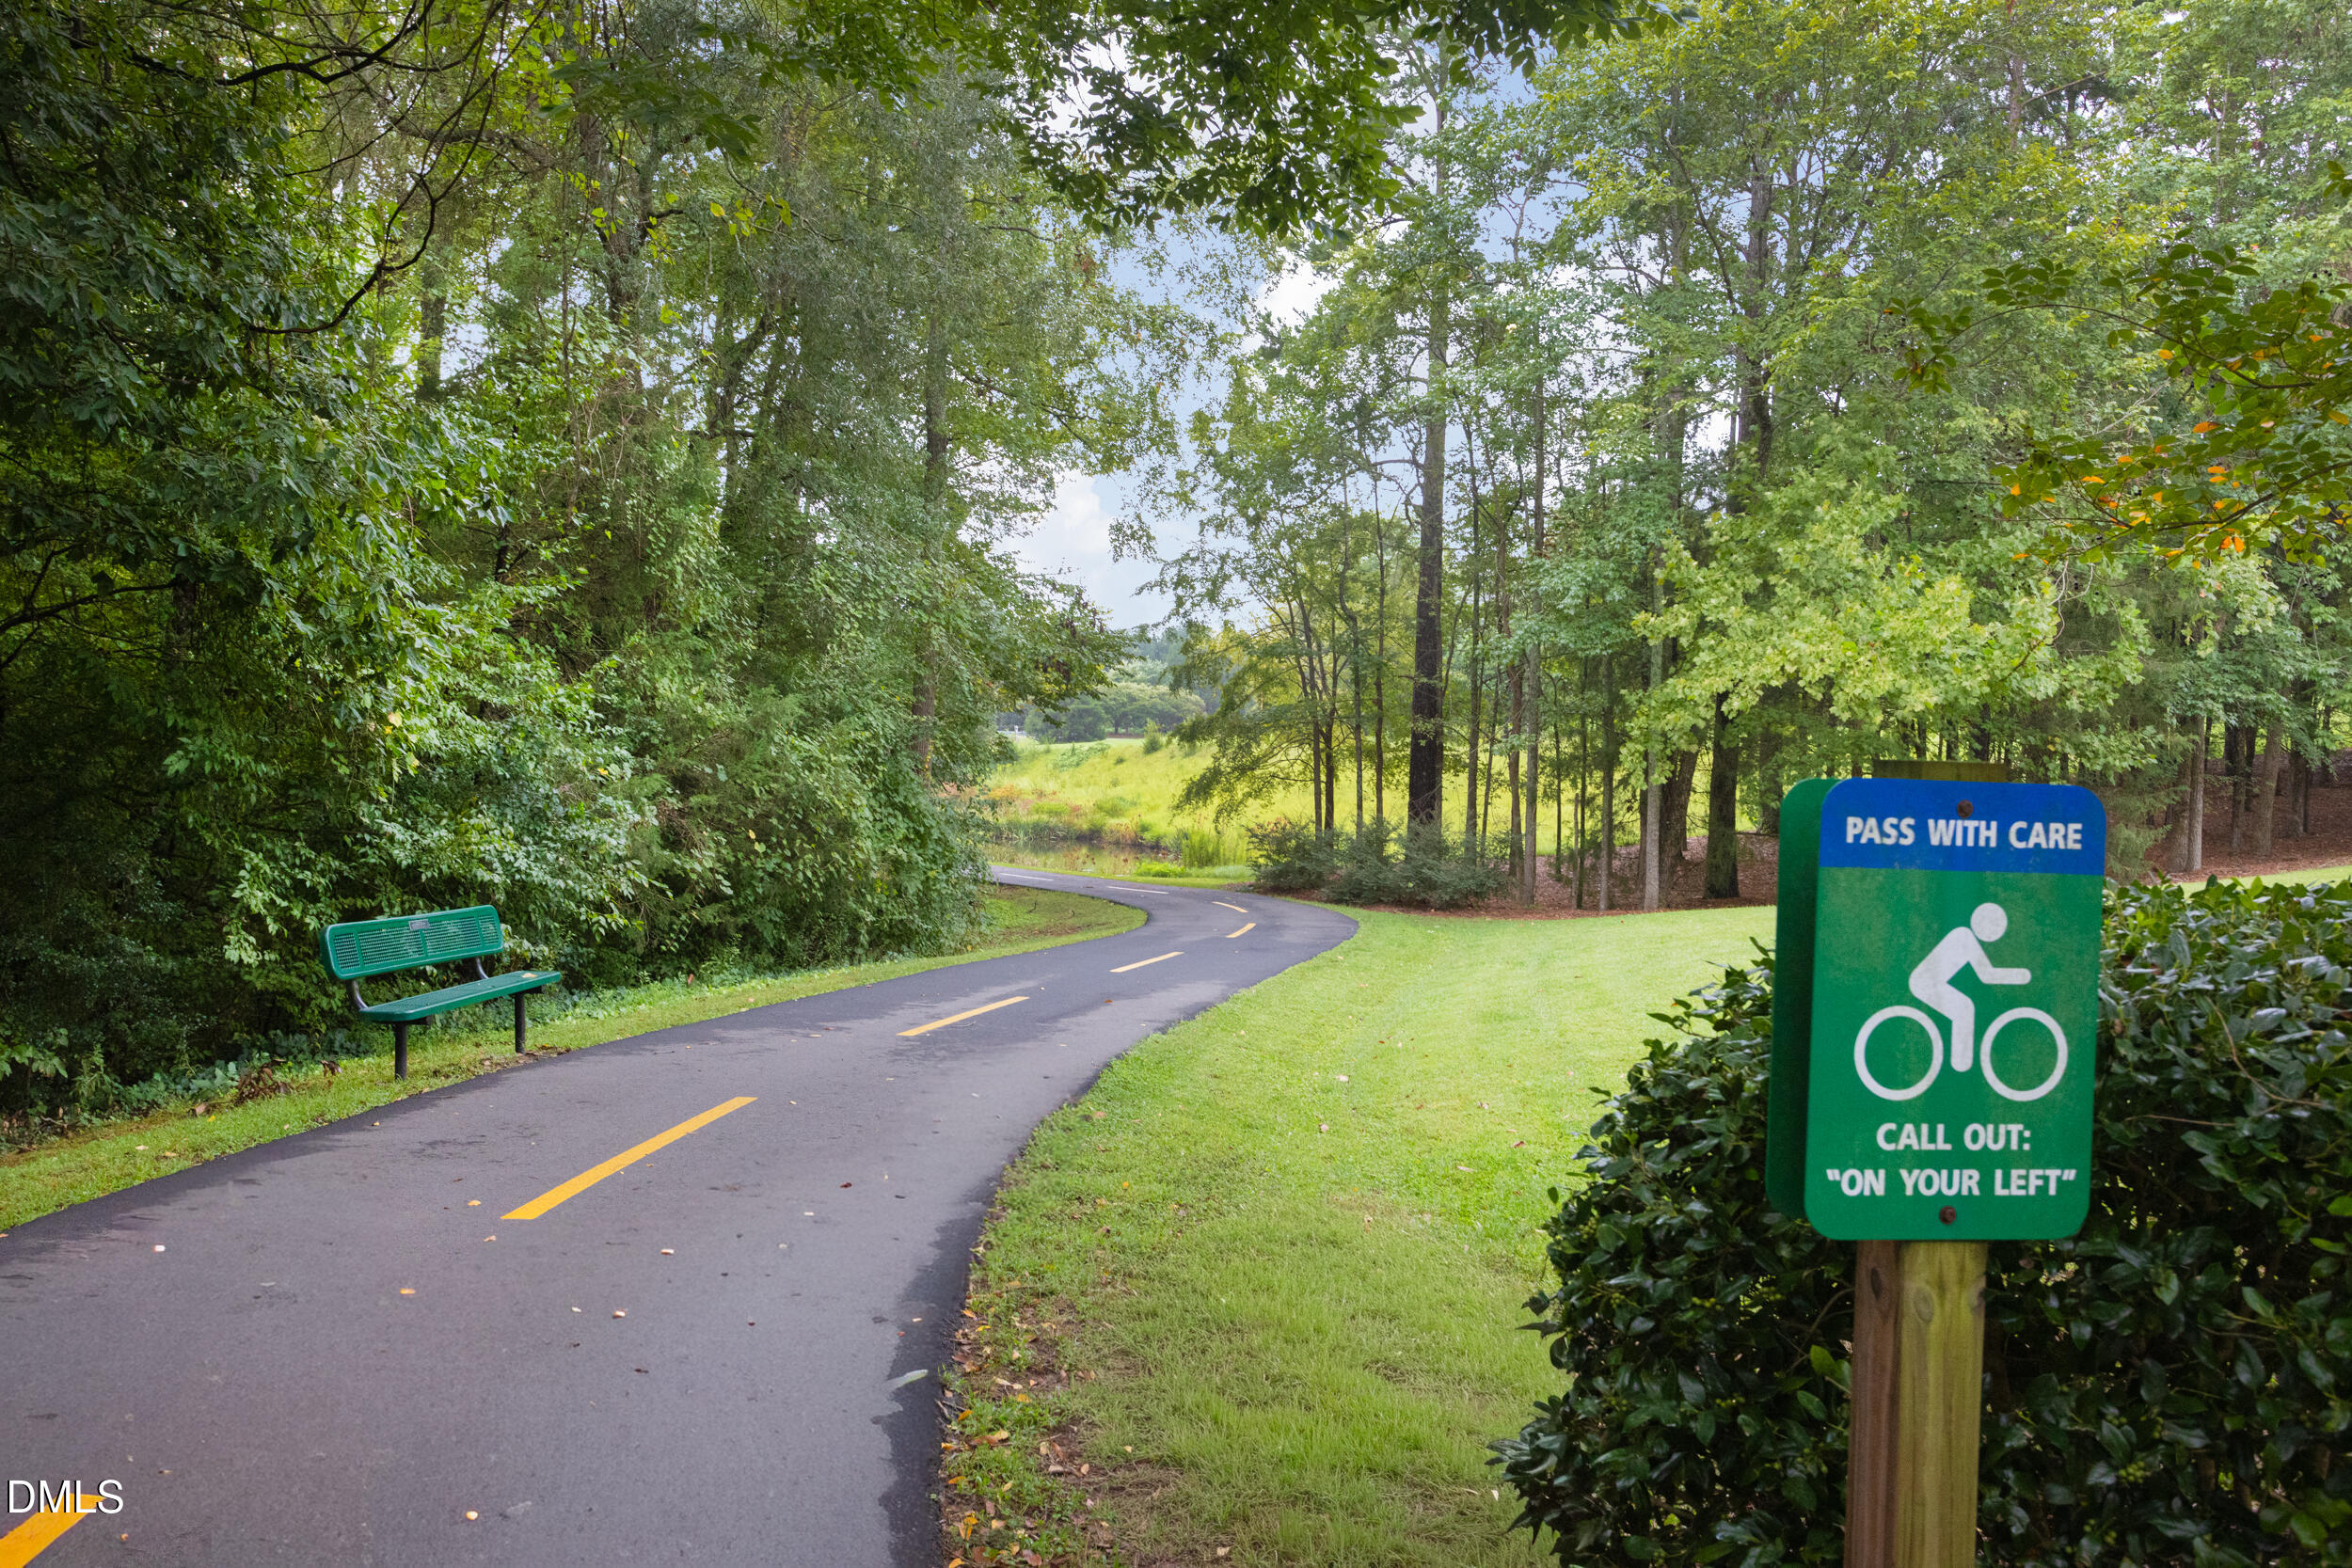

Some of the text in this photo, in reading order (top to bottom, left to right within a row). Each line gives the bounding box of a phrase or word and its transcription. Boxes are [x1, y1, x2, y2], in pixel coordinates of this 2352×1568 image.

[1845, 816, 2083, 850] PASS WITH CARE
[1876, 1123, 2031, 1151] CALL OUT:
[1826, 1168, 2077, 1196] "ON YOUR LEFT"
